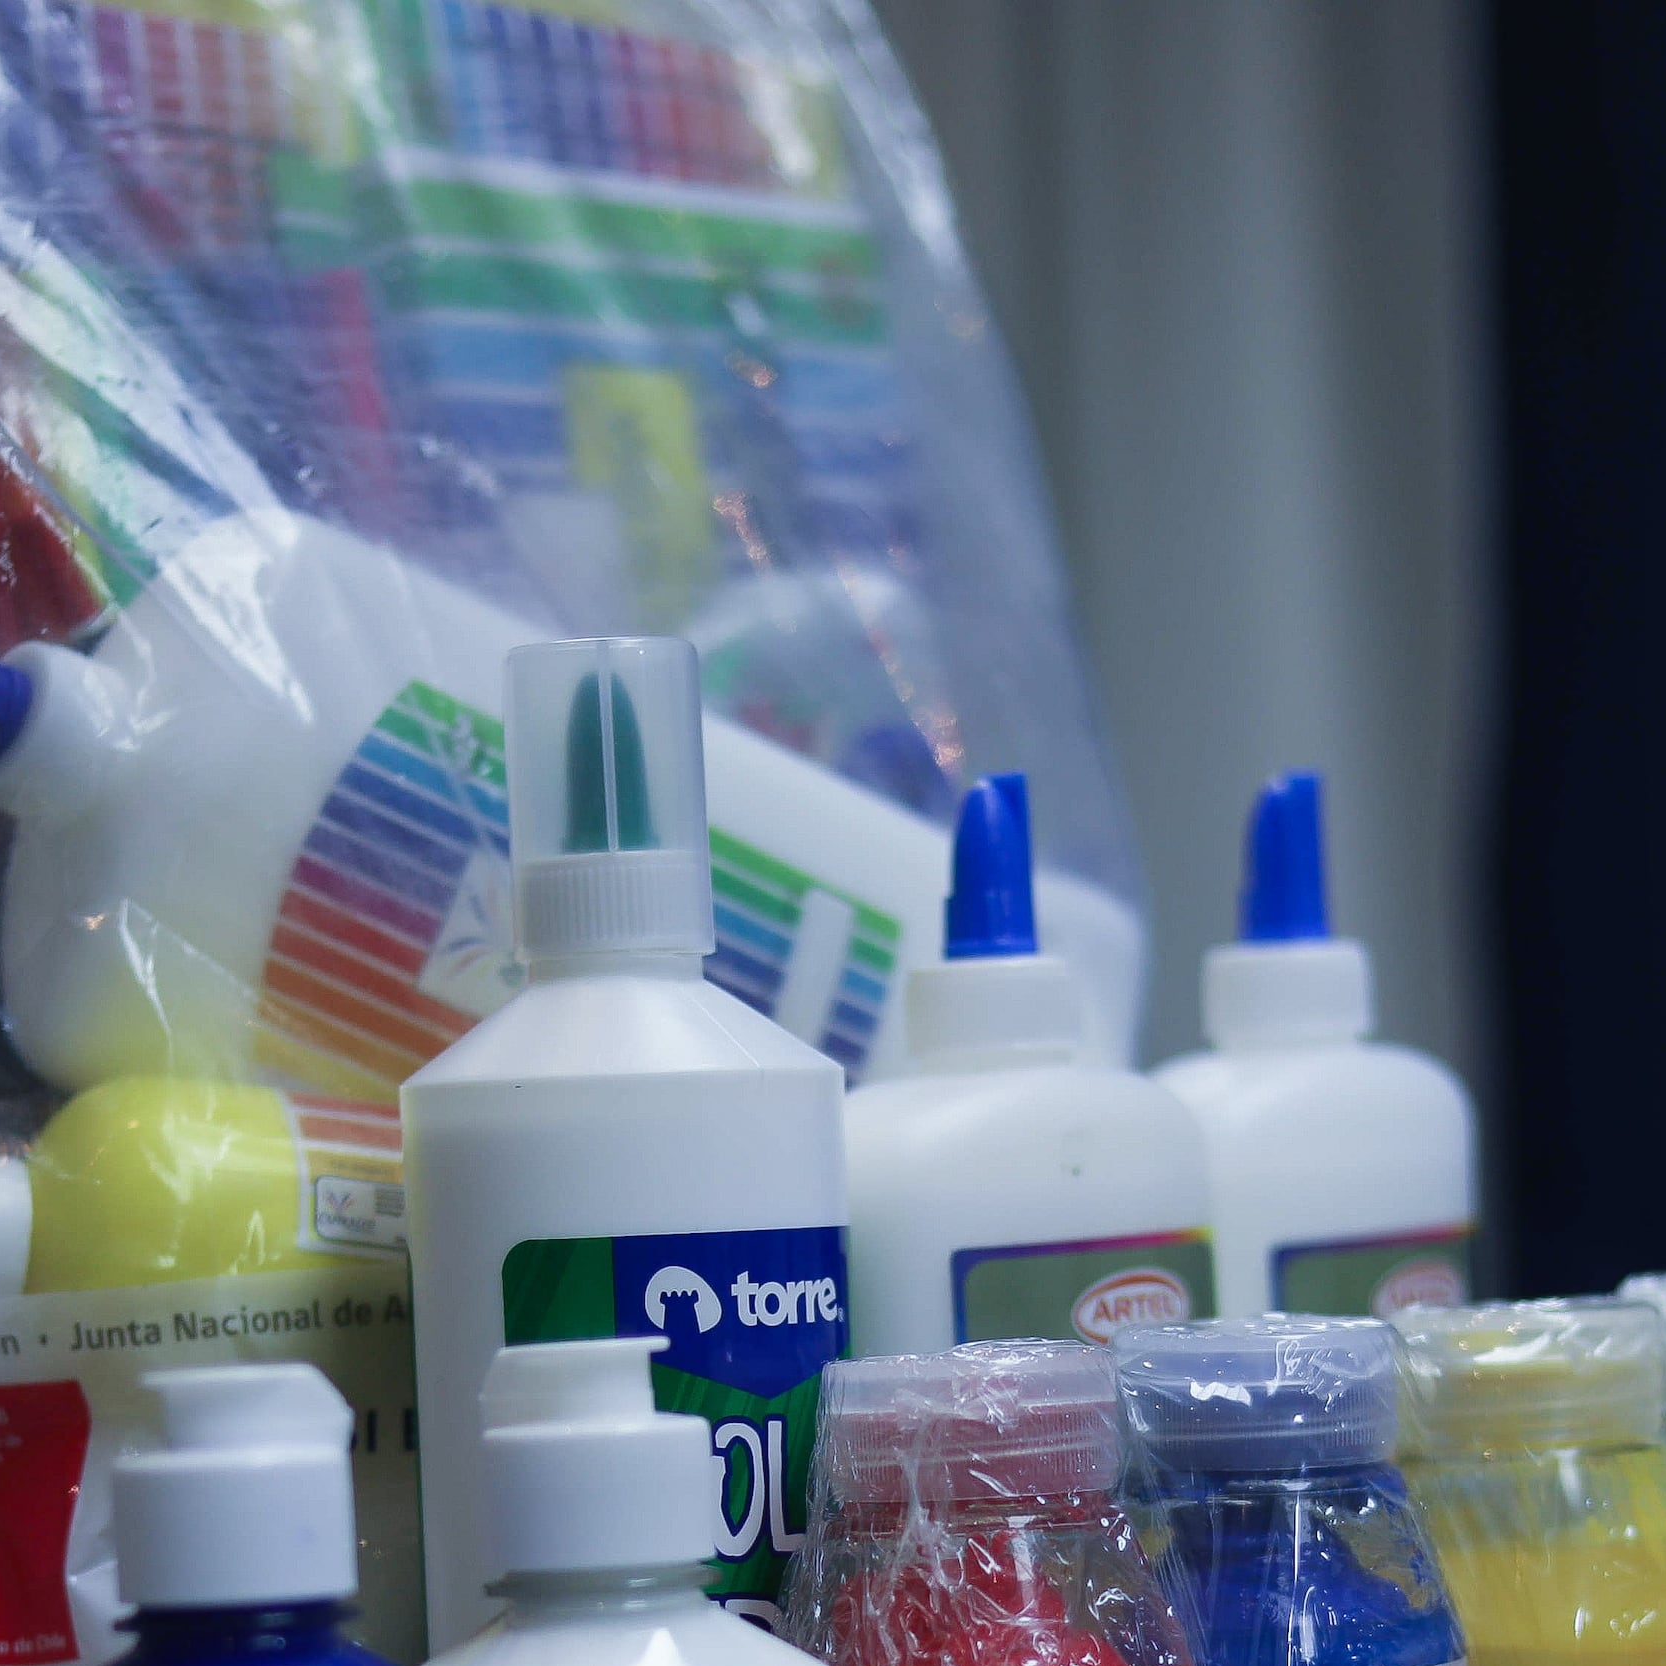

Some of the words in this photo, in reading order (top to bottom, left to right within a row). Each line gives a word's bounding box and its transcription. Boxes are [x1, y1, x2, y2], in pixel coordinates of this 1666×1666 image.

[731, 1270, 837, 1327] torre
[1093, 1293, 1176, 1324] ARTEL
[69, 1317, 162, 1352] Junta
[172, 1304, 323, 1344] Nacional
[335, 1299, 373, 1328] de
